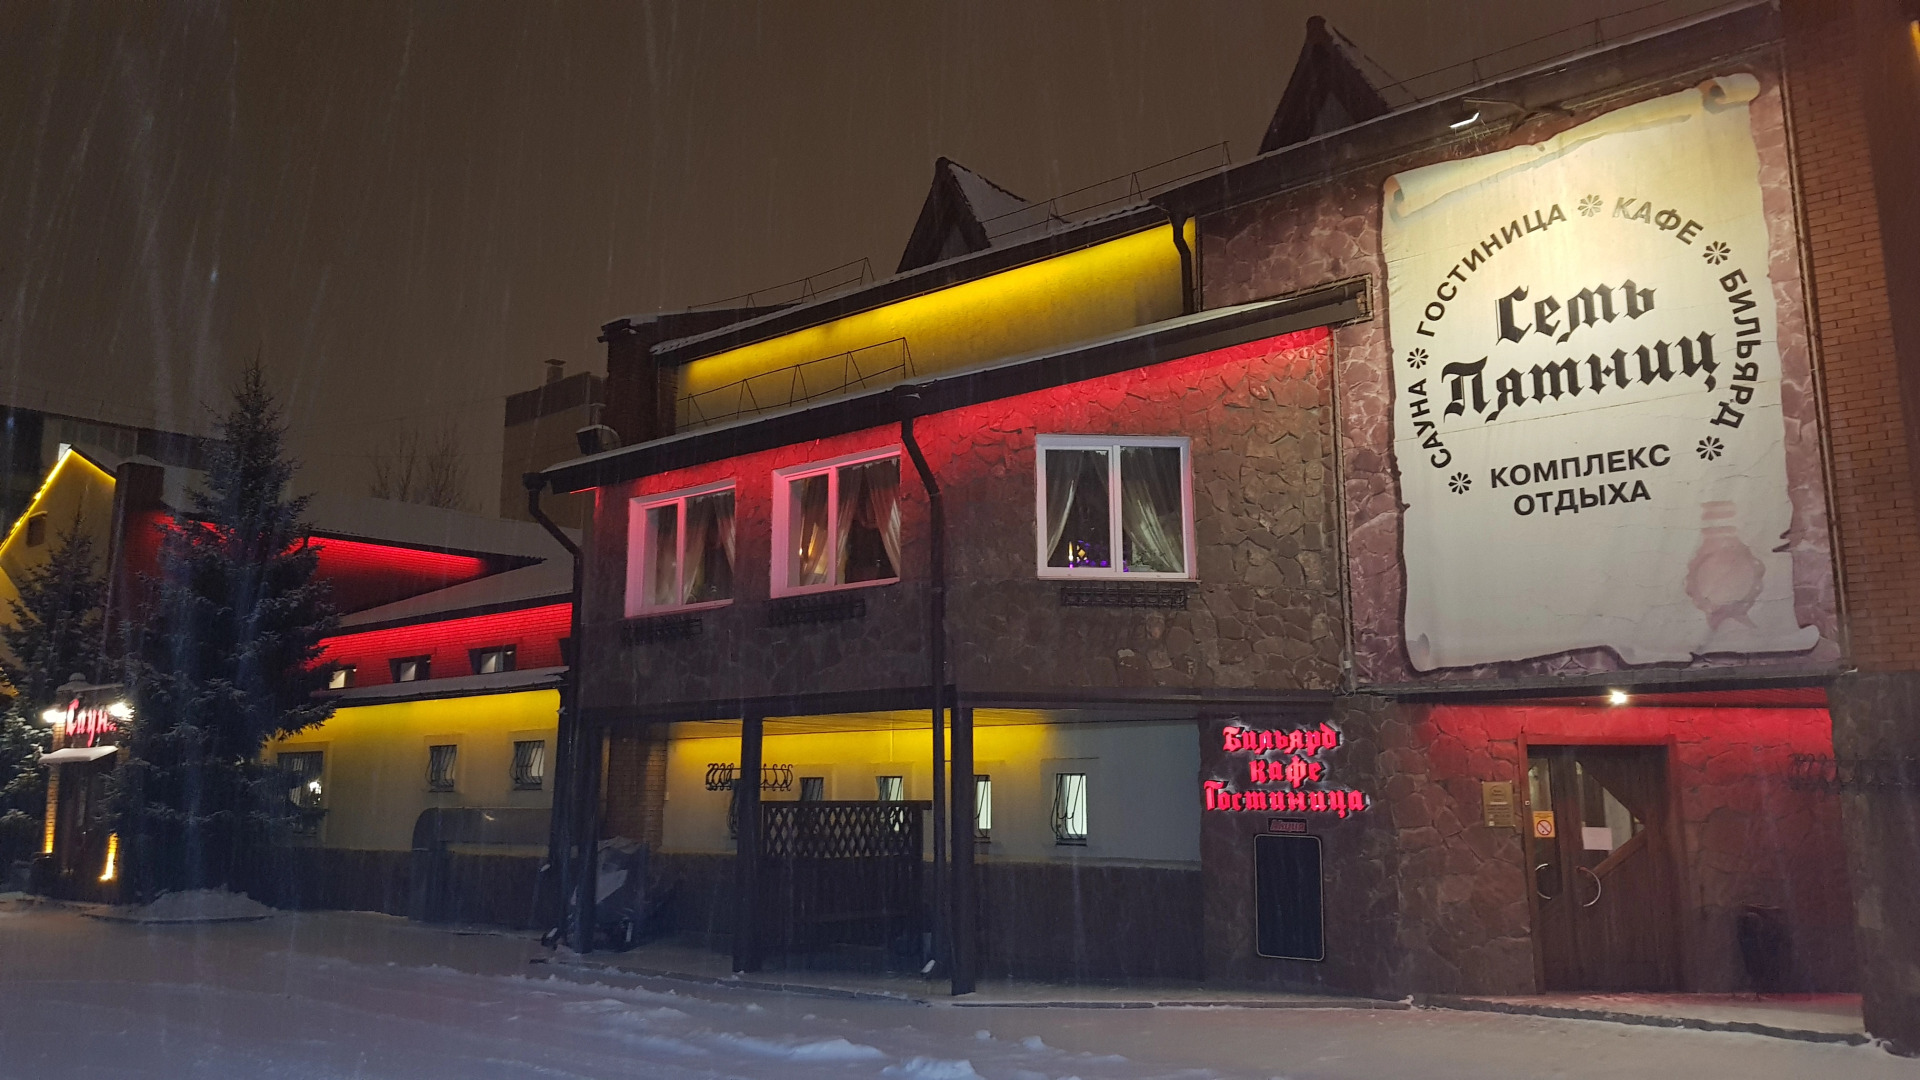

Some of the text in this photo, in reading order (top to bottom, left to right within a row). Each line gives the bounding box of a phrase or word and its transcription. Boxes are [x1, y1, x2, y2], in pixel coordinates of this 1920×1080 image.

[1408, 196, 1761, 468] САУНА ГОСТИНИЦА КАФЕ БИЛЬЯРД
[1495, 278, 1658, 345] Семь
[1441, 330, 1721, 423] Пятниц
[1490, 444, 1672, 488] КОМПЛЕКС
[1513, 479, 1651, 516] ОТДЫХА
[1222, 722, 1339, 756] Бильярд
[1203, 779, 1367, 818] Гостиница
